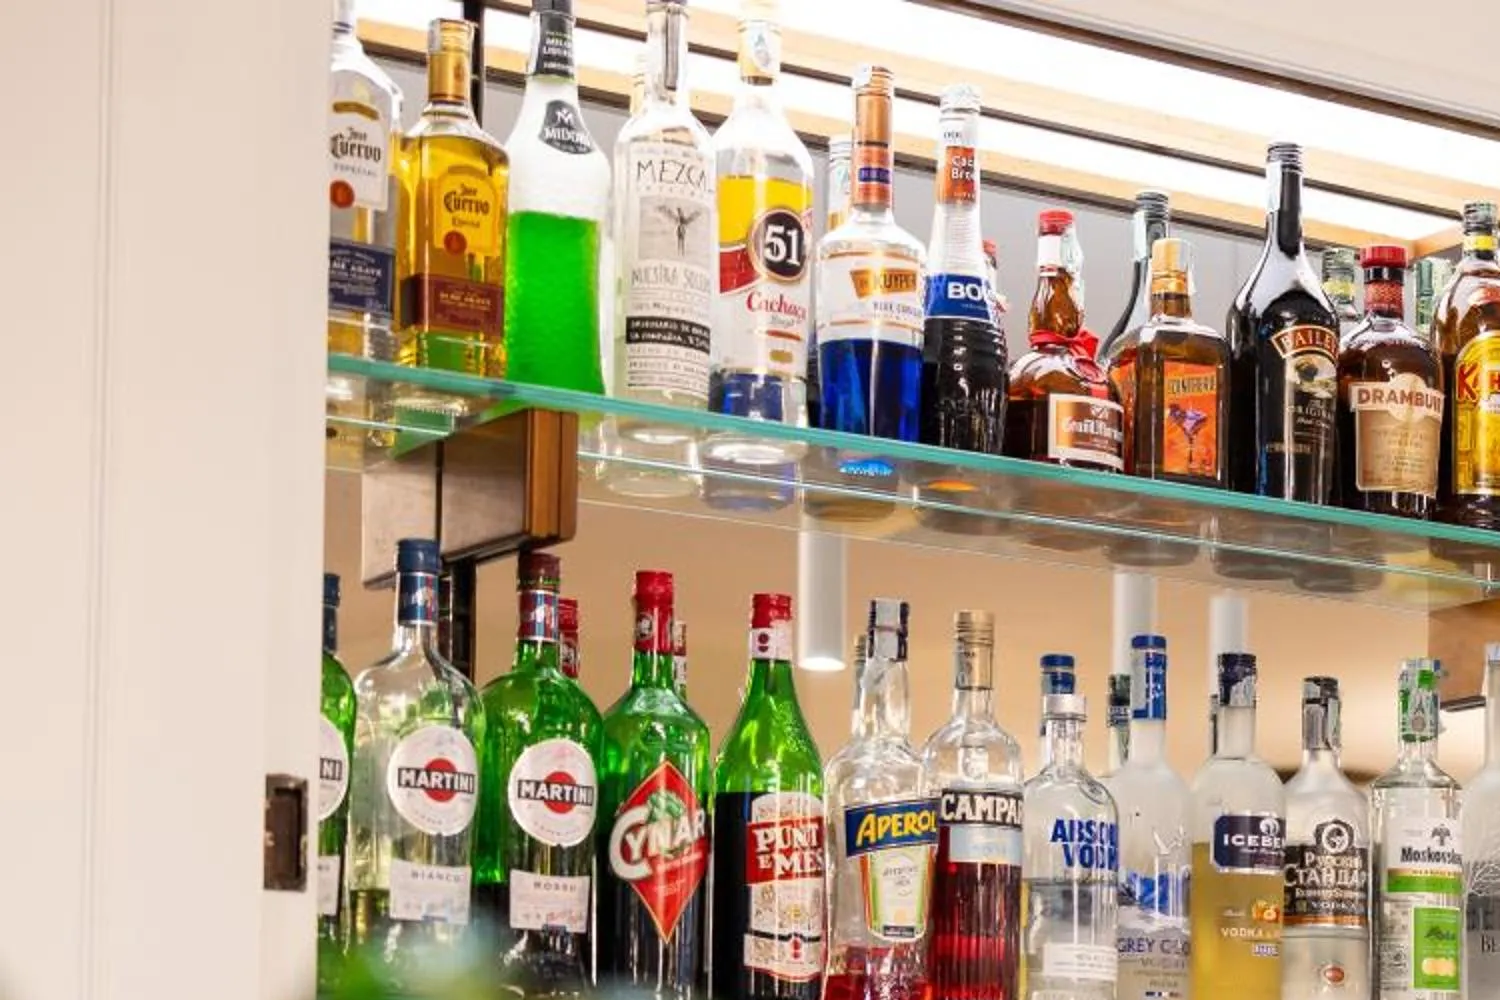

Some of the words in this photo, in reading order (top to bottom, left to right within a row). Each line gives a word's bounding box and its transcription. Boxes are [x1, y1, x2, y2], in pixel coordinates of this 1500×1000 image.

[330, 132, 382, 163] Cuervo
[443, 191, 490, 215] Cuervo
[764, 225, 802, 266] 51
[399, 768, 475, 793] MARTINI
[519, 780, 594, 806] MARTINI
[940, 793, 1023, 825] CAMPA
[609, 803, 706, 881] CYNAR
[755, 823, 820, 853] PUNT
[856, 809, 937, 847] APEROL
[1223, 833, 1286, 849] ICEBE
[1117, 937, 1155, 954] GREY
